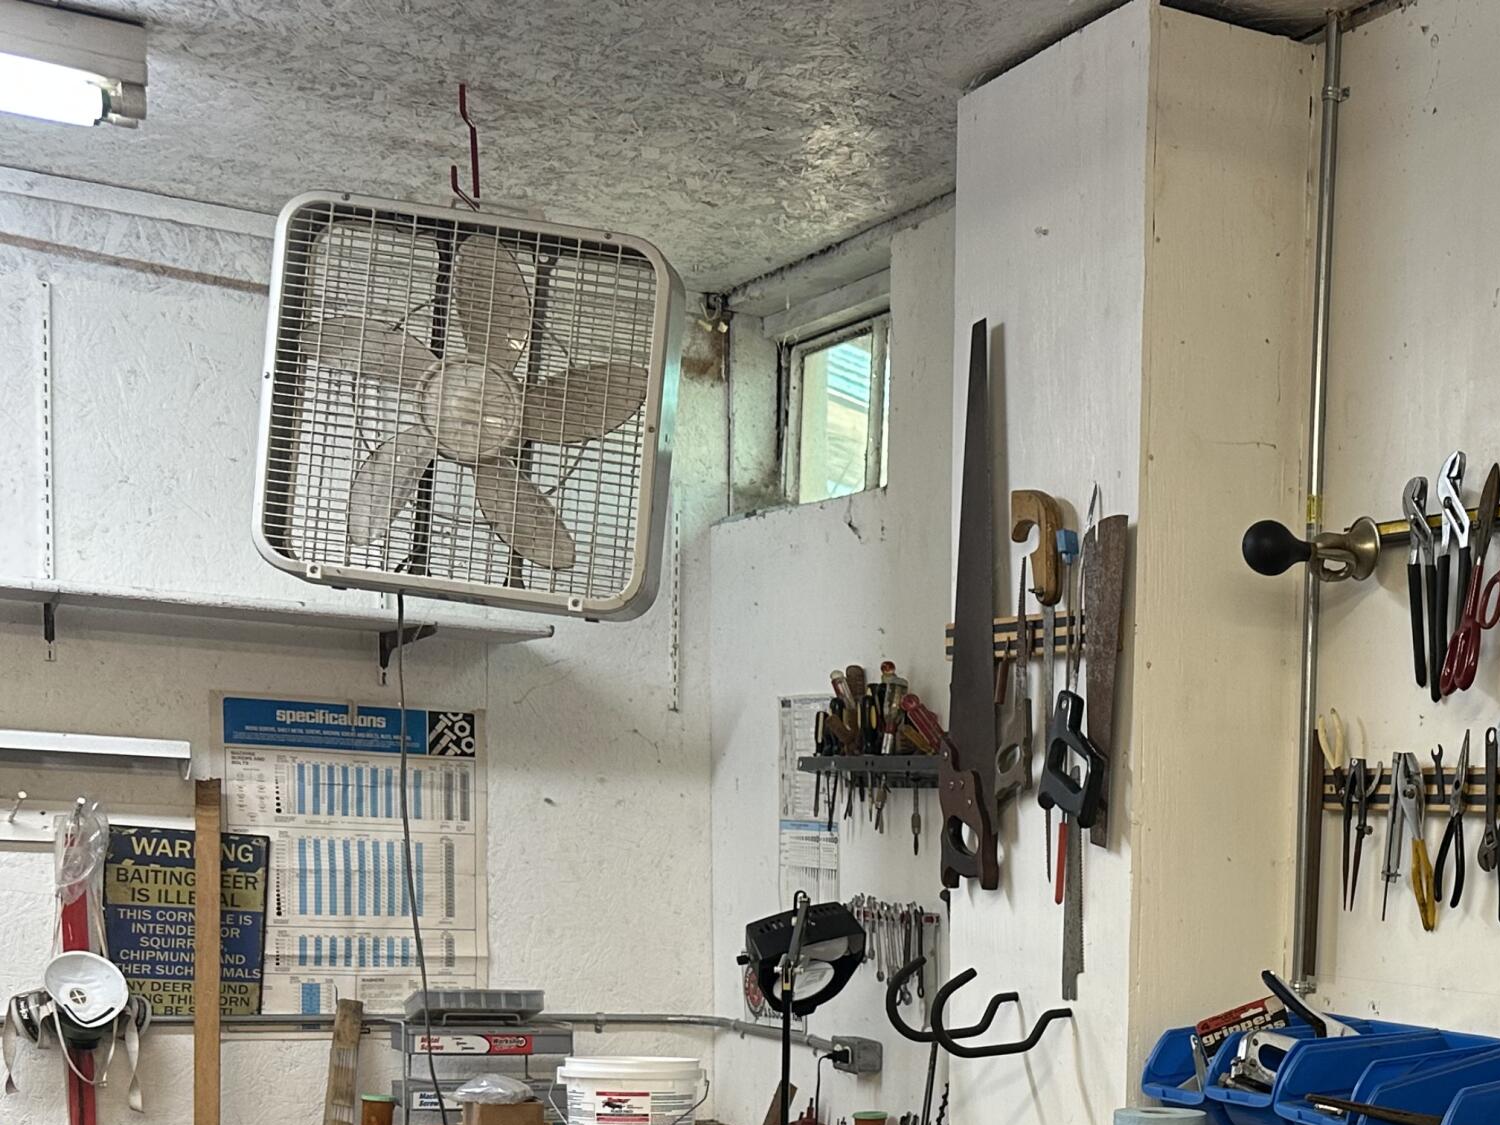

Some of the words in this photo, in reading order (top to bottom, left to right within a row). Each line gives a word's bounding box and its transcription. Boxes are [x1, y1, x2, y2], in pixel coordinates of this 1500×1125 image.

[131, 836, 254, 863] WARNG
[116, 867, 196, 886] BAITING
[221, 874, 258, 891] EER
[131, 887, 150, 902] IS
[158, 889, 241, 908] ILLEAL
[117, 908, 151, 920] THIS
[239, 915, 253, 926] IS
[131, 923, 196, 936] INTENDE
[119, 950, 196, 963] CHIPMUN
[155, 964, 193, 976] SUCH
[127, 981, 146, 991] NY
[151, 982, 191, 992] DEER
[168, 994, 195, 1004] THI
[221, 996, 250, 1006] ORN
[164, 1006, 183, 1016] BE
